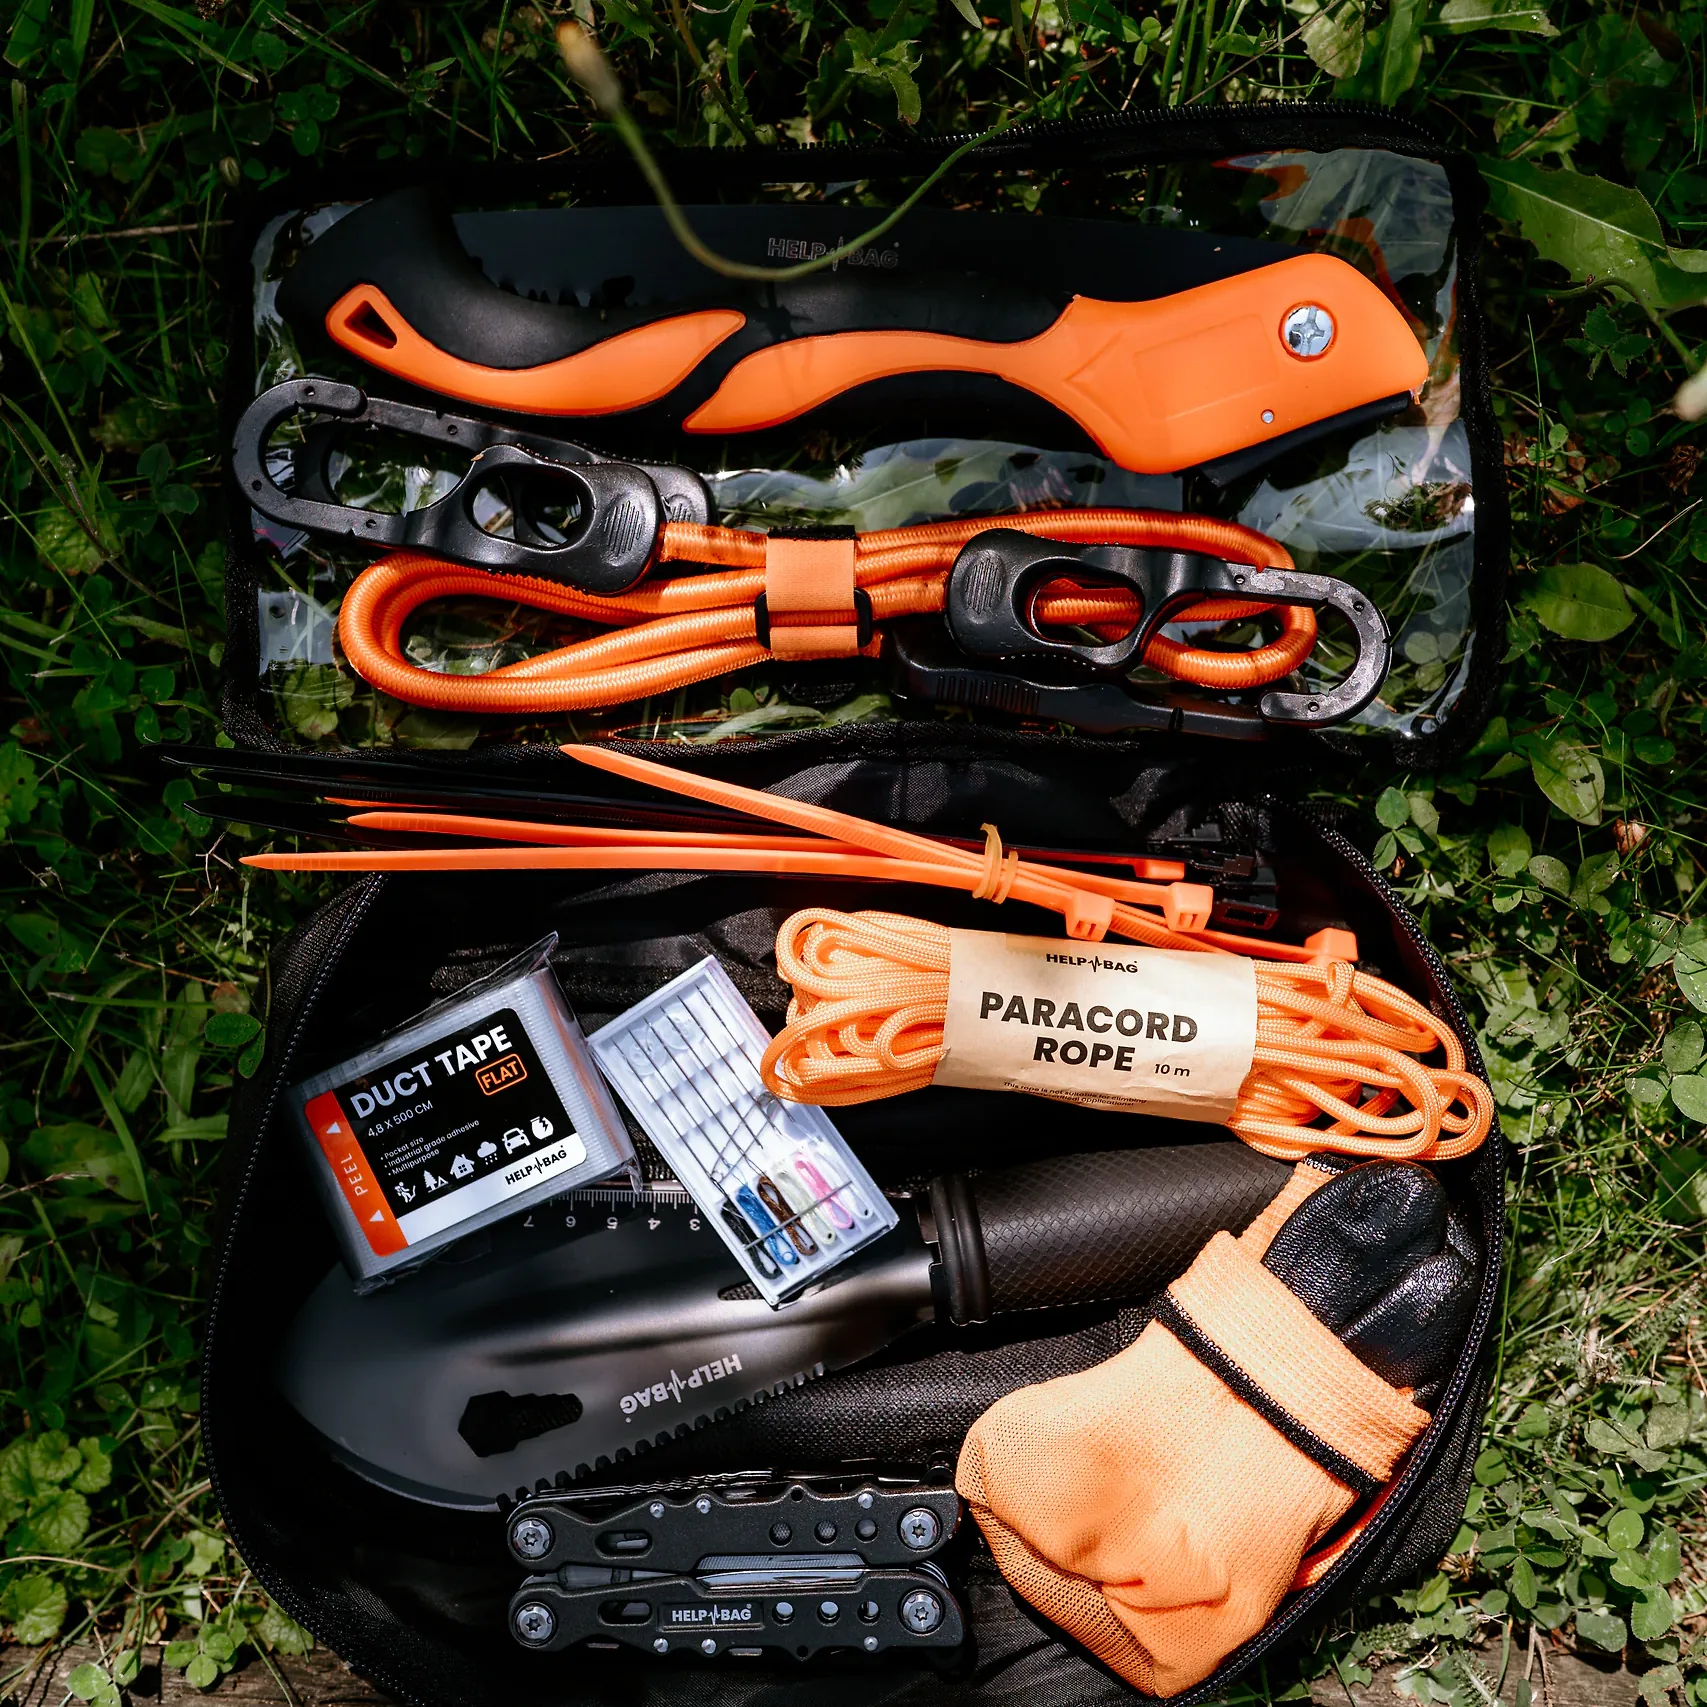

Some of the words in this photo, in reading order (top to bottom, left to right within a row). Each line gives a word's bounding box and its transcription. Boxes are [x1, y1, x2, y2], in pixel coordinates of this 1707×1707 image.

[767, 237, 827, 261] HELP
[847, 247, 899, 269] BAG
[1046, 953, 1087, 967] HELP
[1103, 959, 1138, 973] BAG
[979, 991, 1198, 1043] PARACORD
[1033, 1036, 1136, 1072] ROPE
[351, 1061, 434, 1119] DUCT
[435, 1025, 512, 1076] TAPE
[481, 1060, 521, 1089] FLAT
[1154, 1063, 1170, 1075] 10
[1173, 1066, 1191, 1077] m
[1004, 1081, 1019, 1089] This
[1020, 1085, 1039, 1093] rope
[1111, 1095, 1147, 1104] climbing
[368, 1123, 384, 1137] 4,8
[384, 1119, 393, 1129] X
[393, 1109, 414, 1125] 500
[414, 1100, 434, 1114] CM
[384, 1143, 409, 1160] Pocket
[410, 1137, 424, 1147] size
[388, 1146, 423, 1167] Industrial
[423, 1136, 446, 1152] grade
[446, 1119, 480, 1140] adhesive
[340, 1152, 368, 1196] PEEL
[392, 1148, 440, 1175] Multipurpose
[505, 1165, 532, 1185] HELP
[542, 1149, 567, 1167] BAG
[523, 1215, 534, 1227] 7
[566, 1215, 577, 1228] 6
[607, 1216, 618, 1230] 5
[648, 1217, 661, 1231] 4
[689, 1217, 701, 1231] 3
[687, 1353, 743, 1389] HELP
[619, 1381, 669, 1414] BAG
[672, 1609, 708, 1622] HELP
[720, 1608, 752, 1621] BAG
